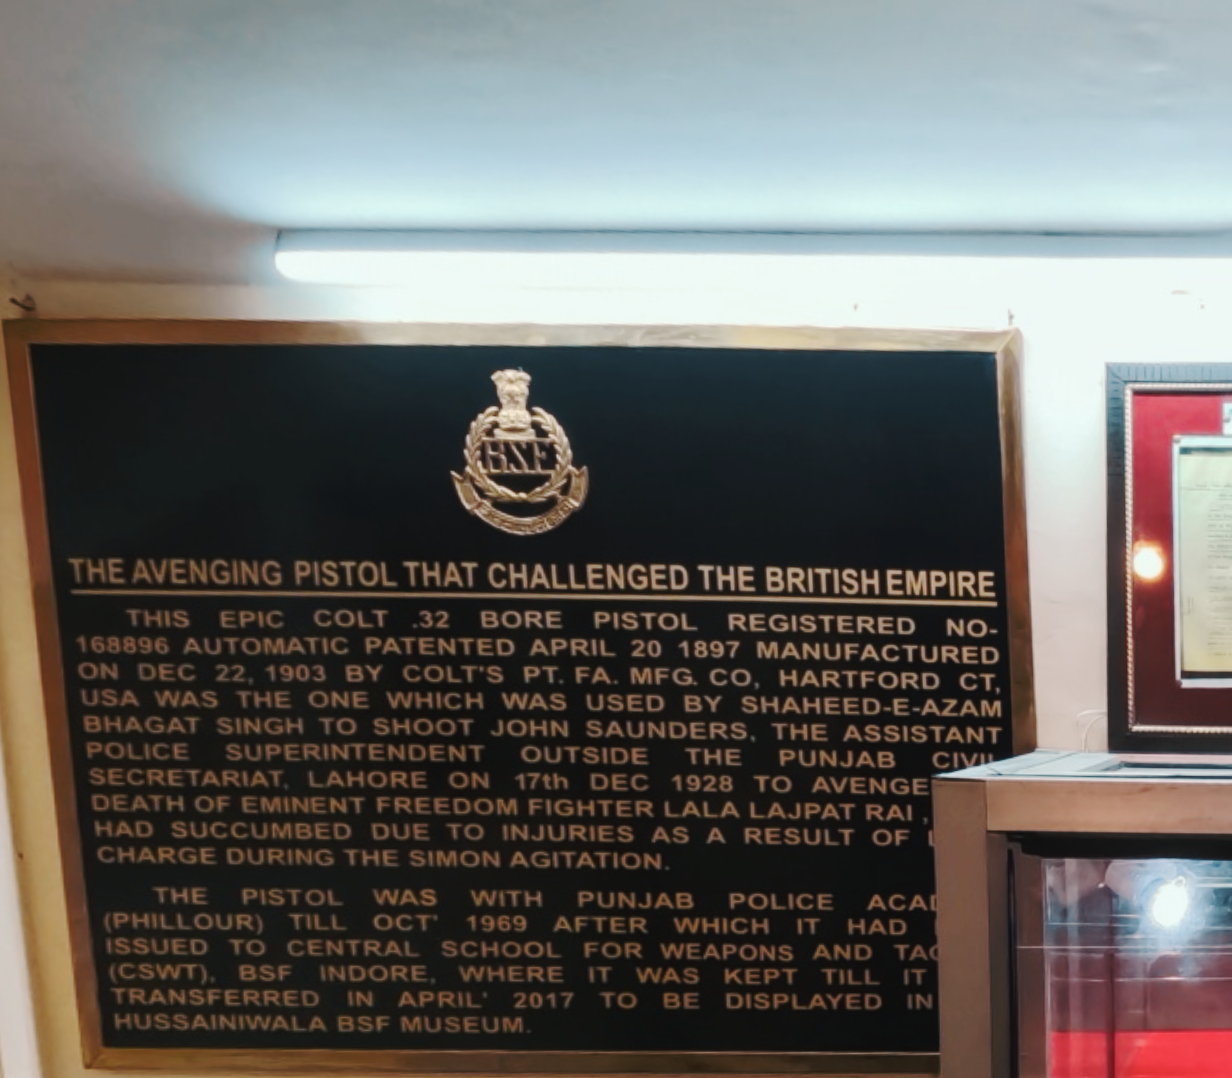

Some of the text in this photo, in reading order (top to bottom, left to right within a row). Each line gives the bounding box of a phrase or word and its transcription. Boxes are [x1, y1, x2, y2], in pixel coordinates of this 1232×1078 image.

[69, 558, 995, 597] THE AVENGING PISTOL THAT CHALLENGED THE BRITISH EMPIRE
[126, 610, 189, 627] THIS
[220, 611, 283, 628] EPIC
[314, 610, 387, 627] COLT
[412, 610, 449, 629] .32
[481, 611, 561, 628] BORE
[594, 612, 697, 630] PISTOL
[728, 614, 915, 634] REGISTERED
[77, 636, 999, 664] 168896 AUTOMATIC PATENTED APRIL 20 1897 MANUFACTURED
[78, 662, 118, 679] ON
[139, 664, 195, 681] DEC
[266, 664, 326, 681] 1903
[346, 665, 381, 682] BY
[403, 665, 503, 683] COLT'S
[780, 670, 939, 689] HARTFORD
[81, 689, 1001, 717] USA WAS THE ONE WHICH WAS USED BY SHAHEED-E-AZAM
[83, 716, 199, 733] BHAGAT
[217, 717, 303, 734] SINGH
[319, 718, 356, 735] TO
[374, 718, 473, 735] SHOOT
[491, 720, 568, 737] JOHN
[772, 723, 827, 741] THE
[844, 725, 1001, 743] ASSISTANT
[86, 742, 188, 760] POLICE
[226, 744, 483, 761] SUPERINTENDENT
[521, 746, 648, 764] OUTSIDE
[686, 748, 741, 765] THE
[779, 749, 895, 768] PUNJAB
[309, 771, 426, 788] LAHORE
[449, 772, 489, 788] ON
[516, 773, 568, 789] 17th
[591, 774, 648, 791] DEC
[672, 775, 733, 792] 1928
[754, 776, 792, 792] TO
[813, 777, 928, 795] AVENGE
[92, 794, 912, 820] DEATH OF EMINENT FREEDOM FIGHTER LALA LAJPAT RAI
[95, 821, 153, 837] HAD
[172, 821, 351, 839] SUCCUMBED
[371, 823, 429, 840] DUE
[447, 824, 484, 840] TO
[503, 824, 633, 842] INJURIES
[652, 827, 689, 843] AS
[707, 828, 725, 843] A
[745, 828, 853, 845] RESULT
[872, 829, 910, 846] OF
[98, 846, 215, 865] CHARGE
[227, 848, 334, 866] DURING
[344, 849, 397, 866] THE
[410, 850, 500, 867] SIMON
[153, 887, 207, 904] THE
[242, 888, 342, 905] PISTOL
[373, 889, 437, 906] WAS
[471, 890, 542, 906] WITH
[578, 891, 694, 909] PUNJAB
[729, 893, 832, 910] POLICE
[104, 912, 263, 933] (PHILLOUR)
[289, 914, 346, 930] TILL
[467, 915, 526, 931] 1969
[554, 916, 646, 933] AFTER
[674, 918, 769, 934] WHICH
[798, 918, 820, 934] IT
[848, 919, 906, 935] HAD
[107, 938, 208, 955] ISSUED
[230, 939, 265, 955] TO
[288, 939, 418, 956] CENTRAL
[442, 941, 560, 957] SCHOOL
[584, 942, 641, 958] FOR
[661, 943, 793, 961] WEAPONS
[813, 944, 872, 960] AND
[239, 965, 290, 981] BSF
[459, 966, 563, 982] WHERE
[589, 967, 611, 982] IT
[637, 968, 699, 984] WAS
[725, 969, 797, 984] KEPT
[822, 969, 879, 984] TILL
[904, 969, 926, 984] IT
[112, 988, 319, 1006] TRANSFERRED
[348, 991, 373, 1006] IN
[514, 992, 573, 1008] 2017
[600, 992, 637, 1008] TO
[663, 993, 699, 1009] BE
[726, 993, 882, 1009] DISPLAYED
[908, 994, 932, 1008] IN
[115, 1013, 326, 1031] HUSSAINIWALA
[338, 1016, 389, 1032] BSF
